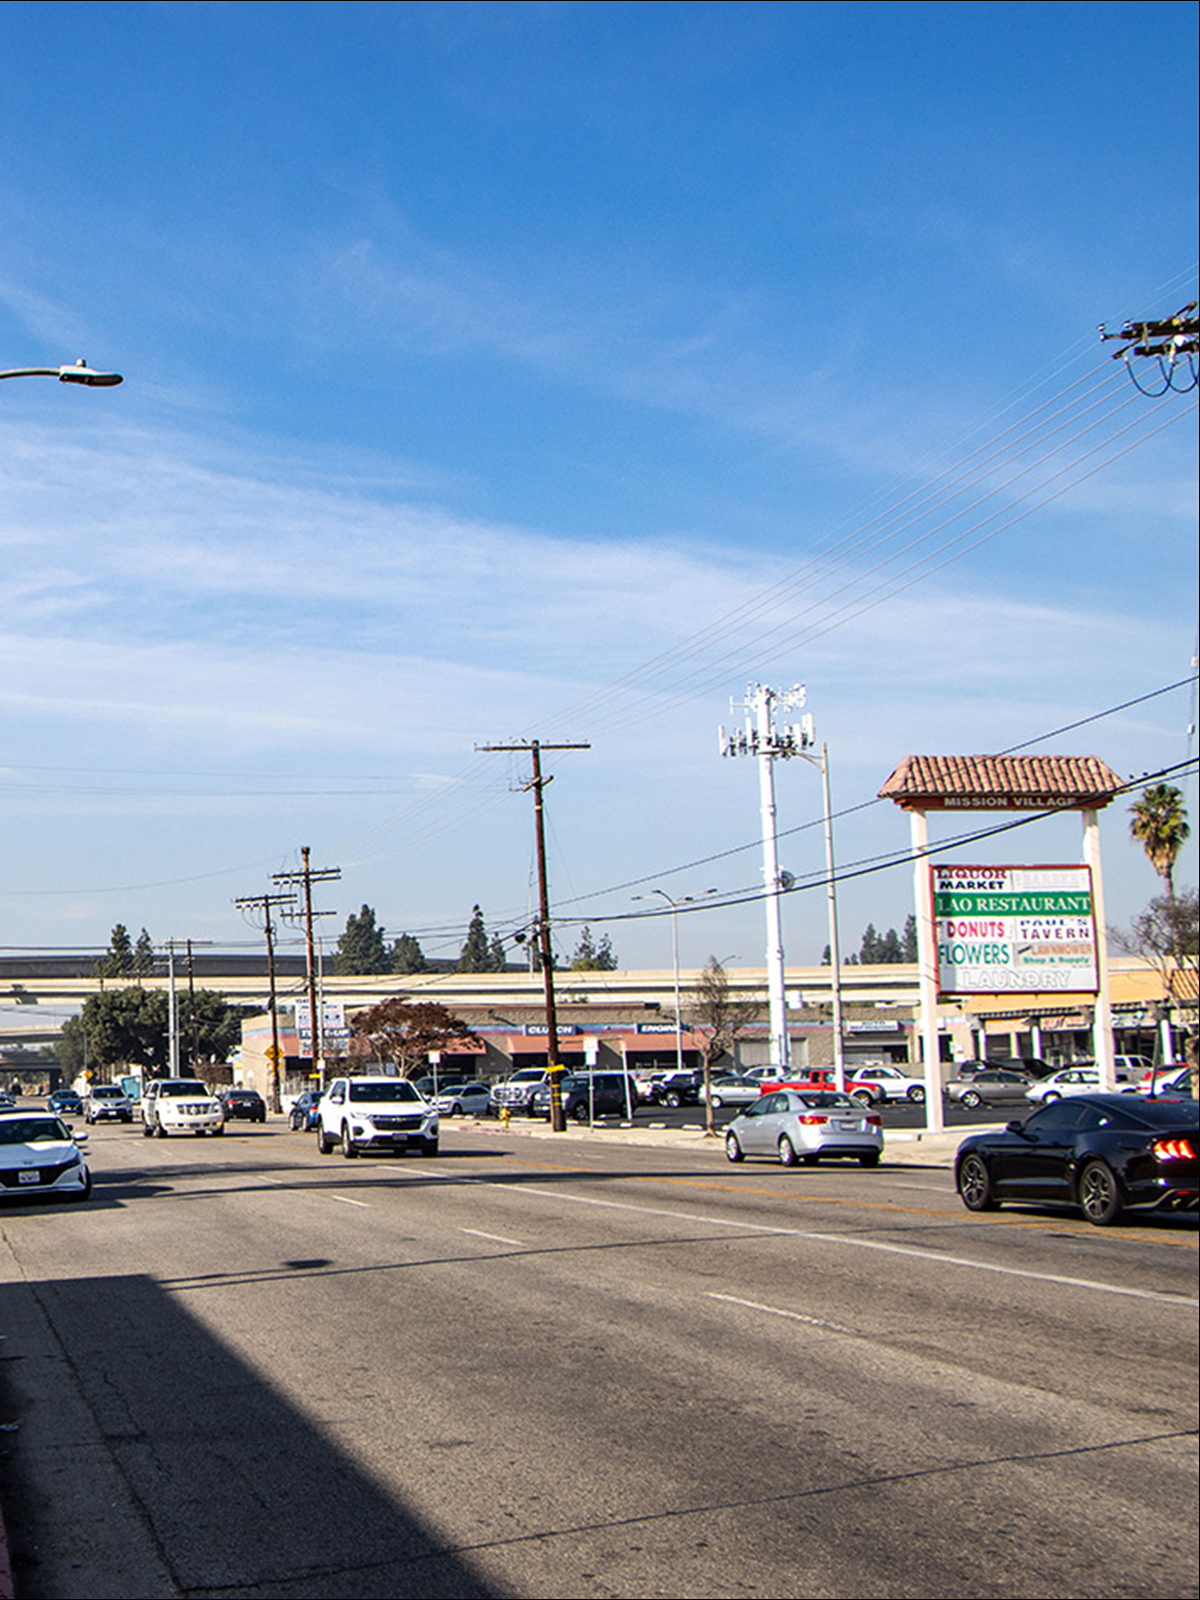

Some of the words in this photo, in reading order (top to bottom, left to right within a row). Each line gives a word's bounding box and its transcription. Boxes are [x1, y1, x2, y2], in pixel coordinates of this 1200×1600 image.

[944, 797, 1008, 807] MISSION
[1012, 797, 1077, 807] VILLAGE
[936, 868, 1007, 880] LIQUOR
[939, 881, 1004, 889] MARKET
[977, 897, 1090, 912] RESTAURANT
[947, 921, 1005, 938] DONUTS
[1021, 928, 1089, 939] TAVERN
[938, 944, 1010, 965] FLOWERS
[963, 970, 1071, 989] LAUNDRY
[528, 1026, 573, 1034] CLUCH
